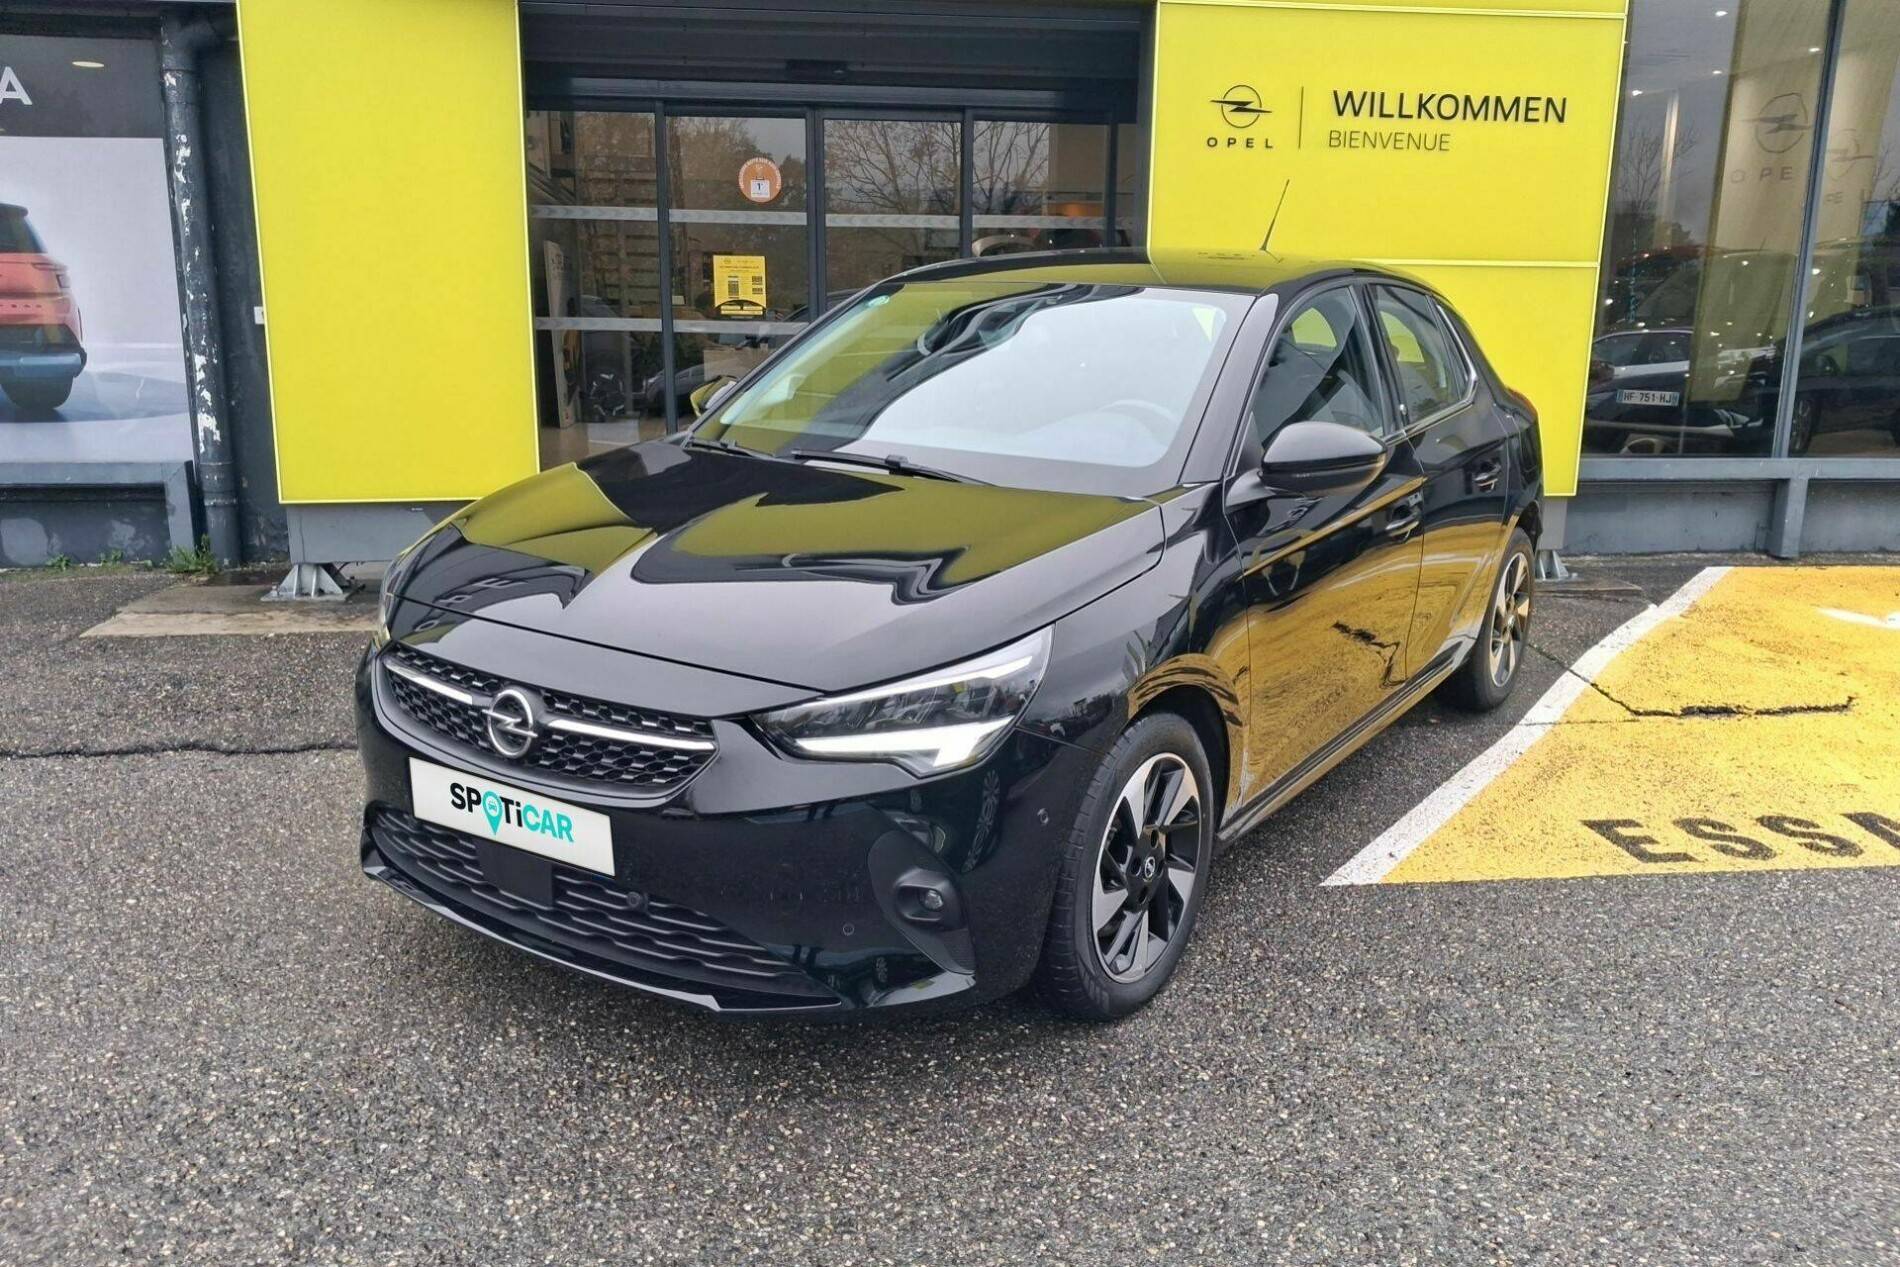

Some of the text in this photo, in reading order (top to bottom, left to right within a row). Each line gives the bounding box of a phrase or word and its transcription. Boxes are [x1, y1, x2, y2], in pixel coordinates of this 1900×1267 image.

[1332, 89, 1568, 124] WILLKOMMEN
[1206, 136, 1274, 149] OPEL
[1329, 130, 1451, 151] BIENVENUE
